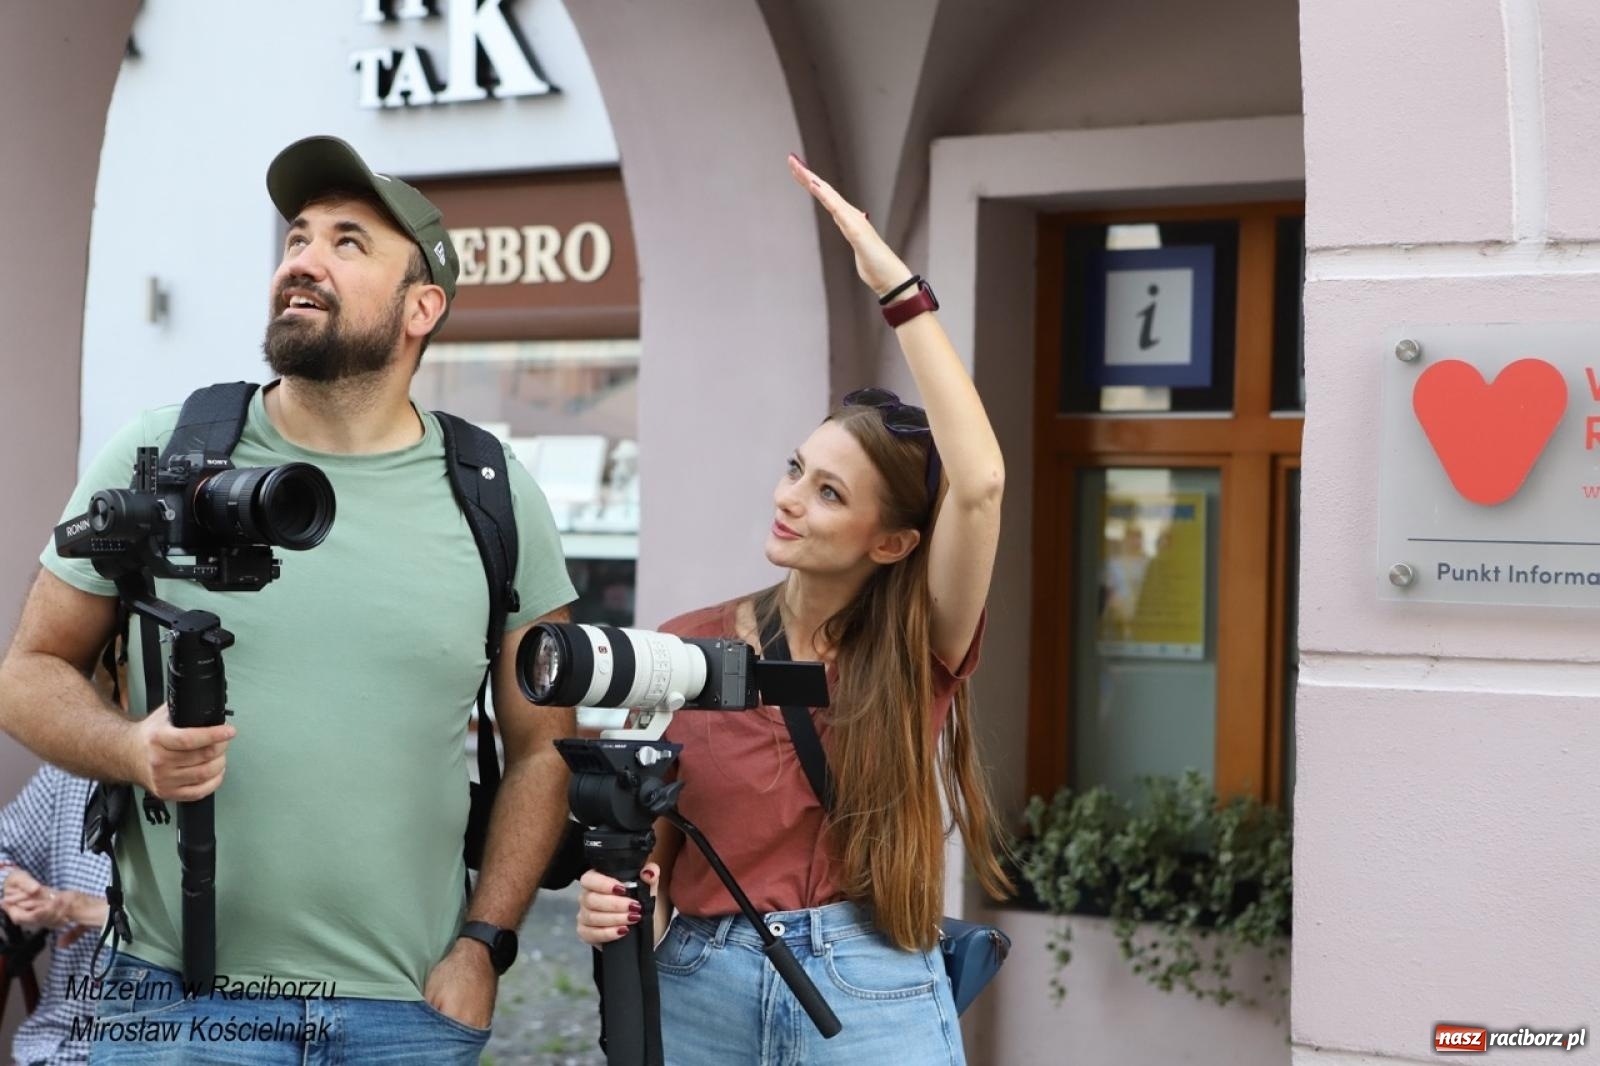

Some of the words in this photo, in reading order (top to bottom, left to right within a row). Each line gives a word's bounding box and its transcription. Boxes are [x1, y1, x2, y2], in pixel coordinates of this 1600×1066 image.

[1135, 284, 1160, 351] i
[65, 518, 91, 537] RONIN
[1437, 562, 1501, 582] Punkt
